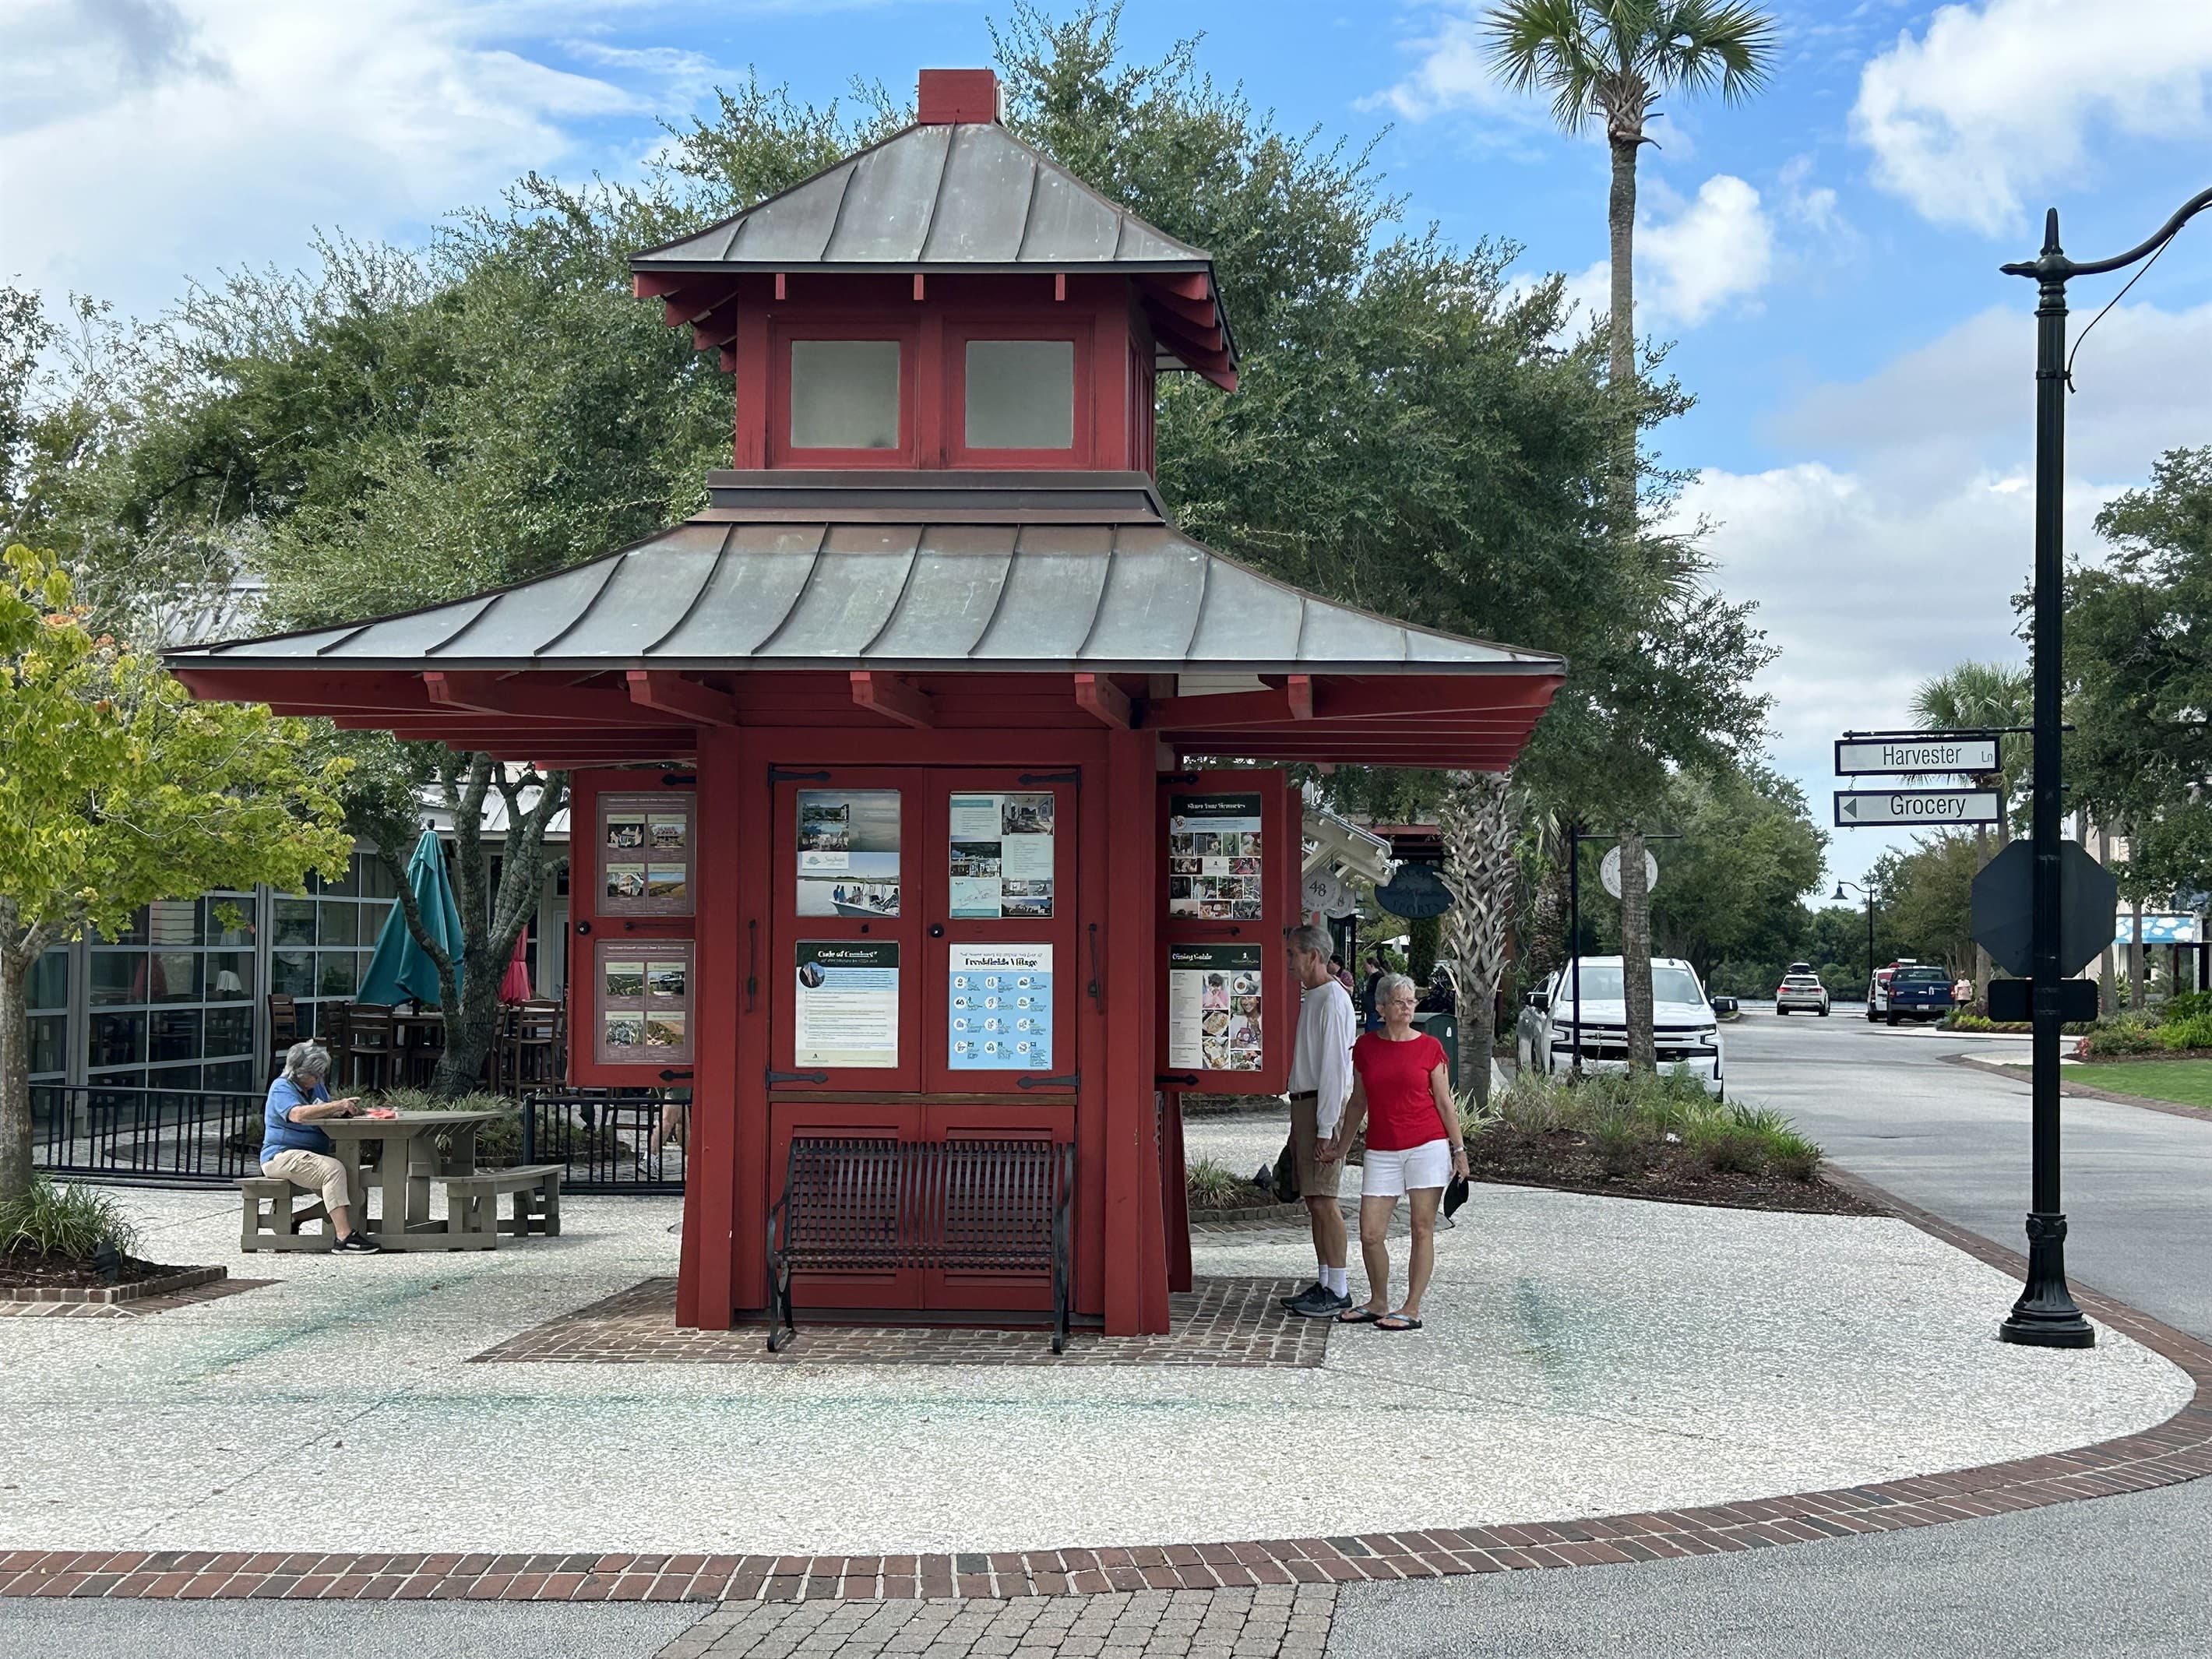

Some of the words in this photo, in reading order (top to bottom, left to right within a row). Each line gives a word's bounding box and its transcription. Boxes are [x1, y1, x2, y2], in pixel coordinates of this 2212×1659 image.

[1883, 745, 1962, 766] Harvester
[1981, 750, 1993, 763] Ln
[1890, 794, 1967, 818] Grocery
[1309, 880, 1327, 897] 48
